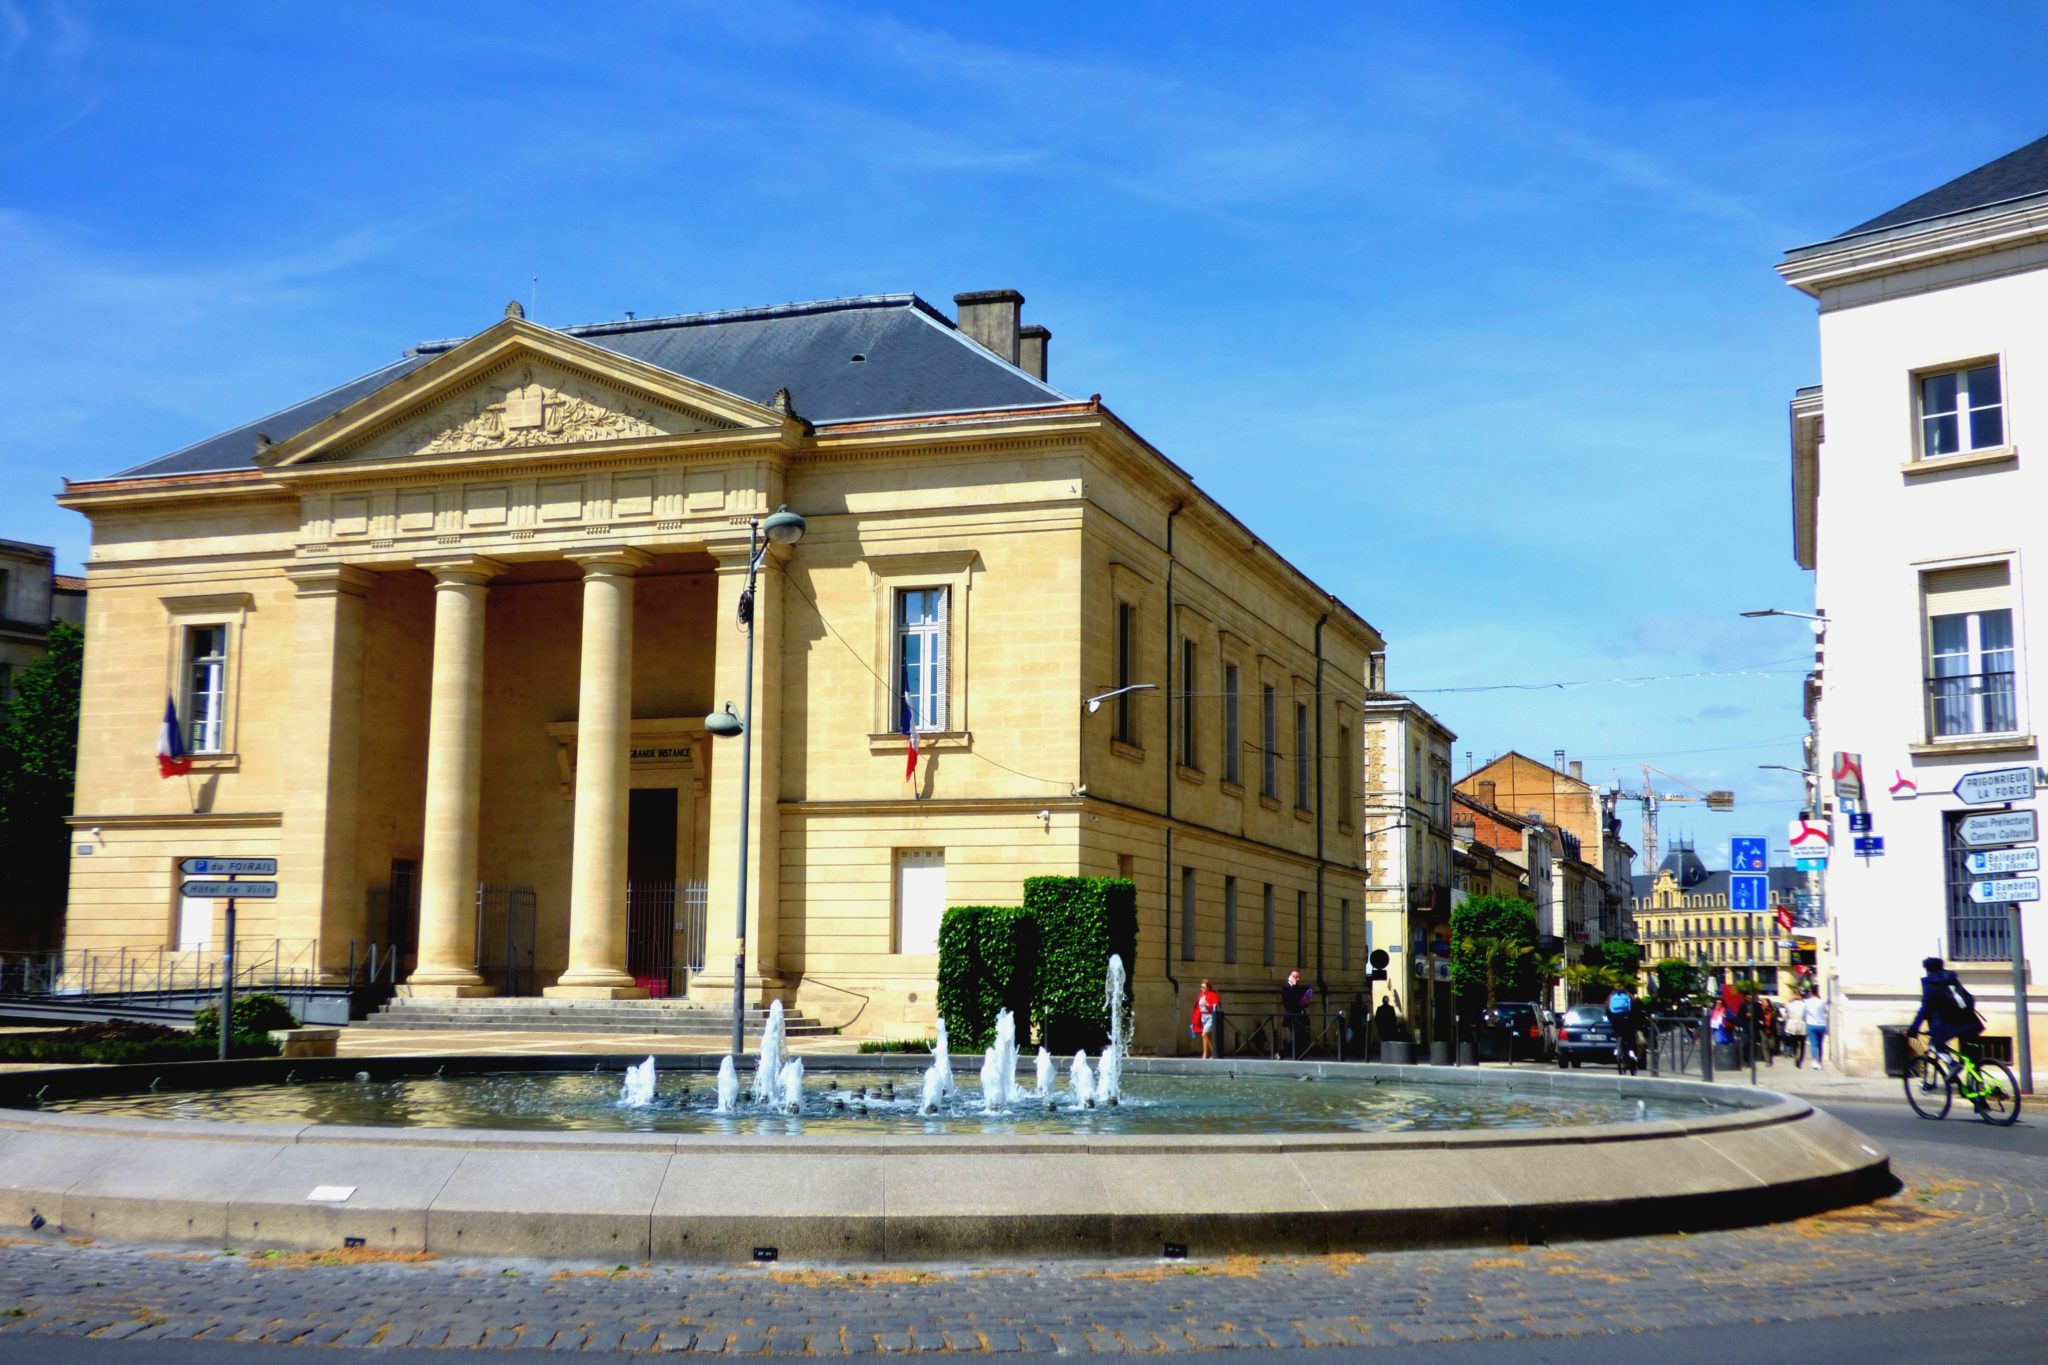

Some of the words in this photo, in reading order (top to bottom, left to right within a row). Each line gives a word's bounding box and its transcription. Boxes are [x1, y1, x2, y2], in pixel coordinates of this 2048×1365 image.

[658, 747, 690, 757] INSTANCE
[1967, 773, 2027, 787] PRIGONRIEUX
[1978, 790, 1989, 798] LA
[1996, 785, 2029, 796] FORCE
[1970, 820, 1988, 829] Sous
[1990, 817, 2030, 827] Préfecture
[1972, 832, 1996, 841] Centre
[2000, 829, 2031, 839] Culturel
[1988, 852, 2035, 863] Bellegarde
[210, 863, 224, 871] du
[229, 862, 272, 871] FOIRAIL
[190, 885, 220, 893] Hôtel
[226, 885, 239, 893] de
[246, 885, 272, 893] Ville
[1996, 882, 2036, 891] Gambetta
